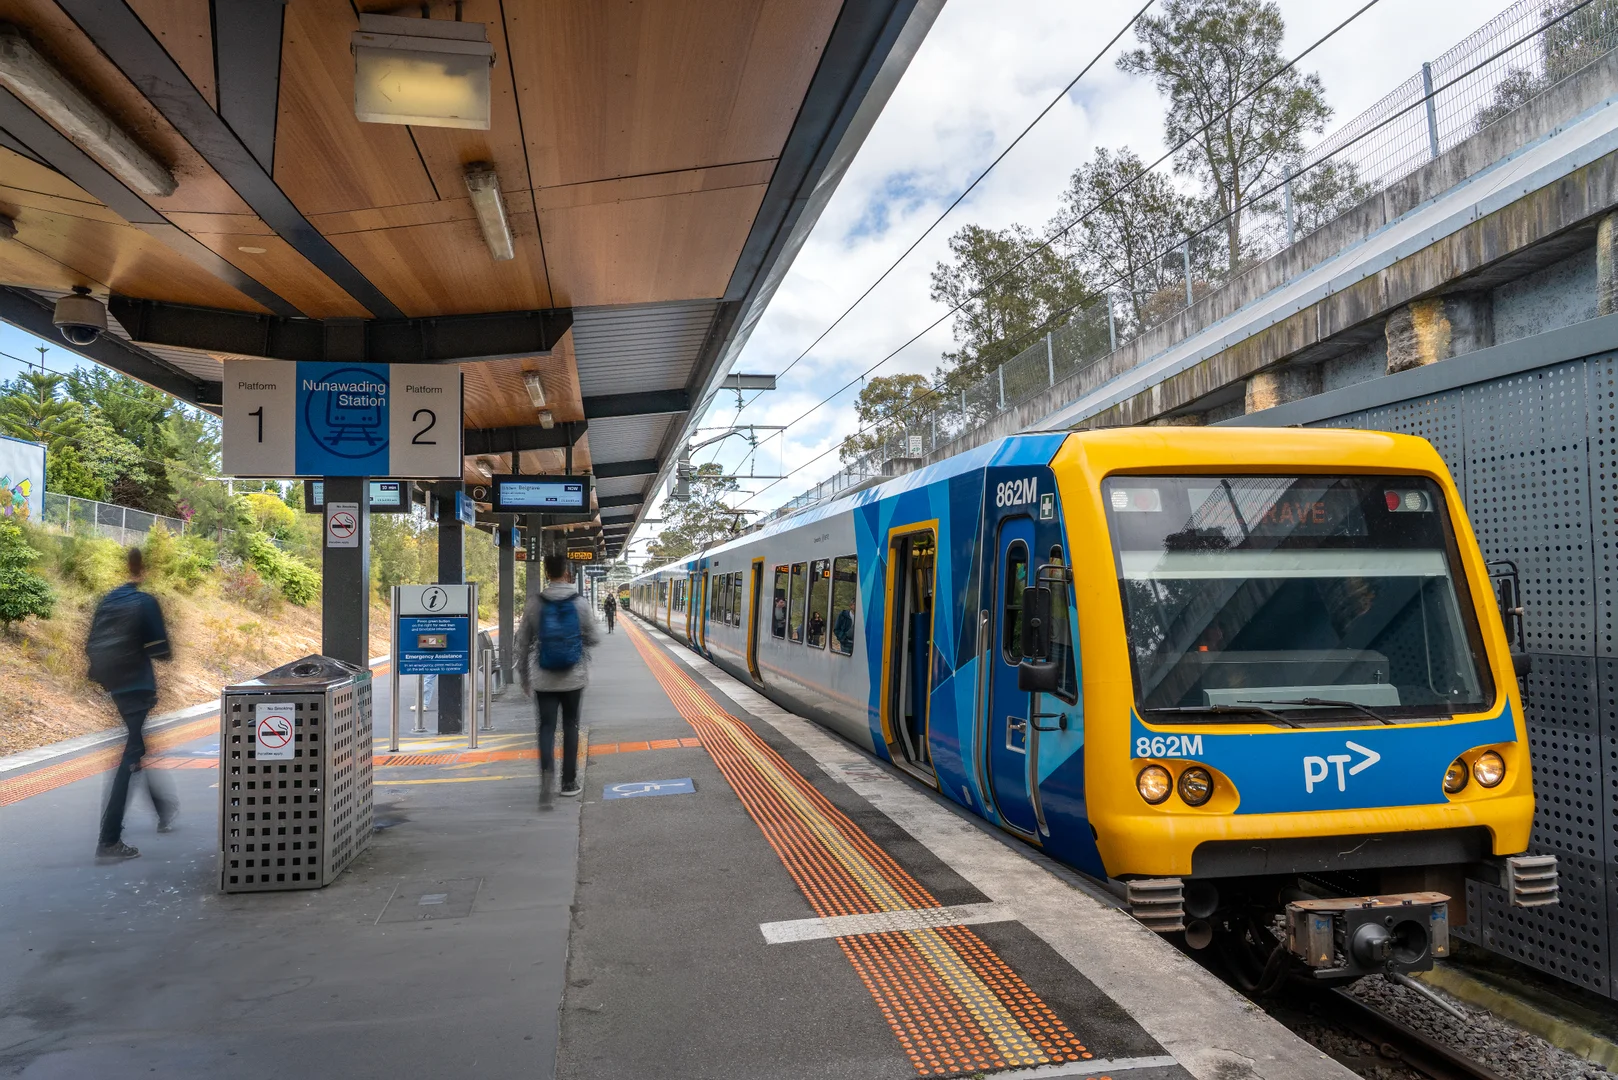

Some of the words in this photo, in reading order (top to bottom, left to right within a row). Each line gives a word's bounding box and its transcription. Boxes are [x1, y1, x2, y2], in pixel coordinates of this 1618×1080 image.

[238, 381, 277, 391] Platform
[303, 379, 386, 395] Nunawading
[405, 385, 443, 394] Platform
[339, 394, 386, 407] Station
[248, 406, 263, 443] 1
[411, 408, 437, 445] 2
[996, 476, 1038, 508] 862M
[1136, 735, 1204, 758] 862M
